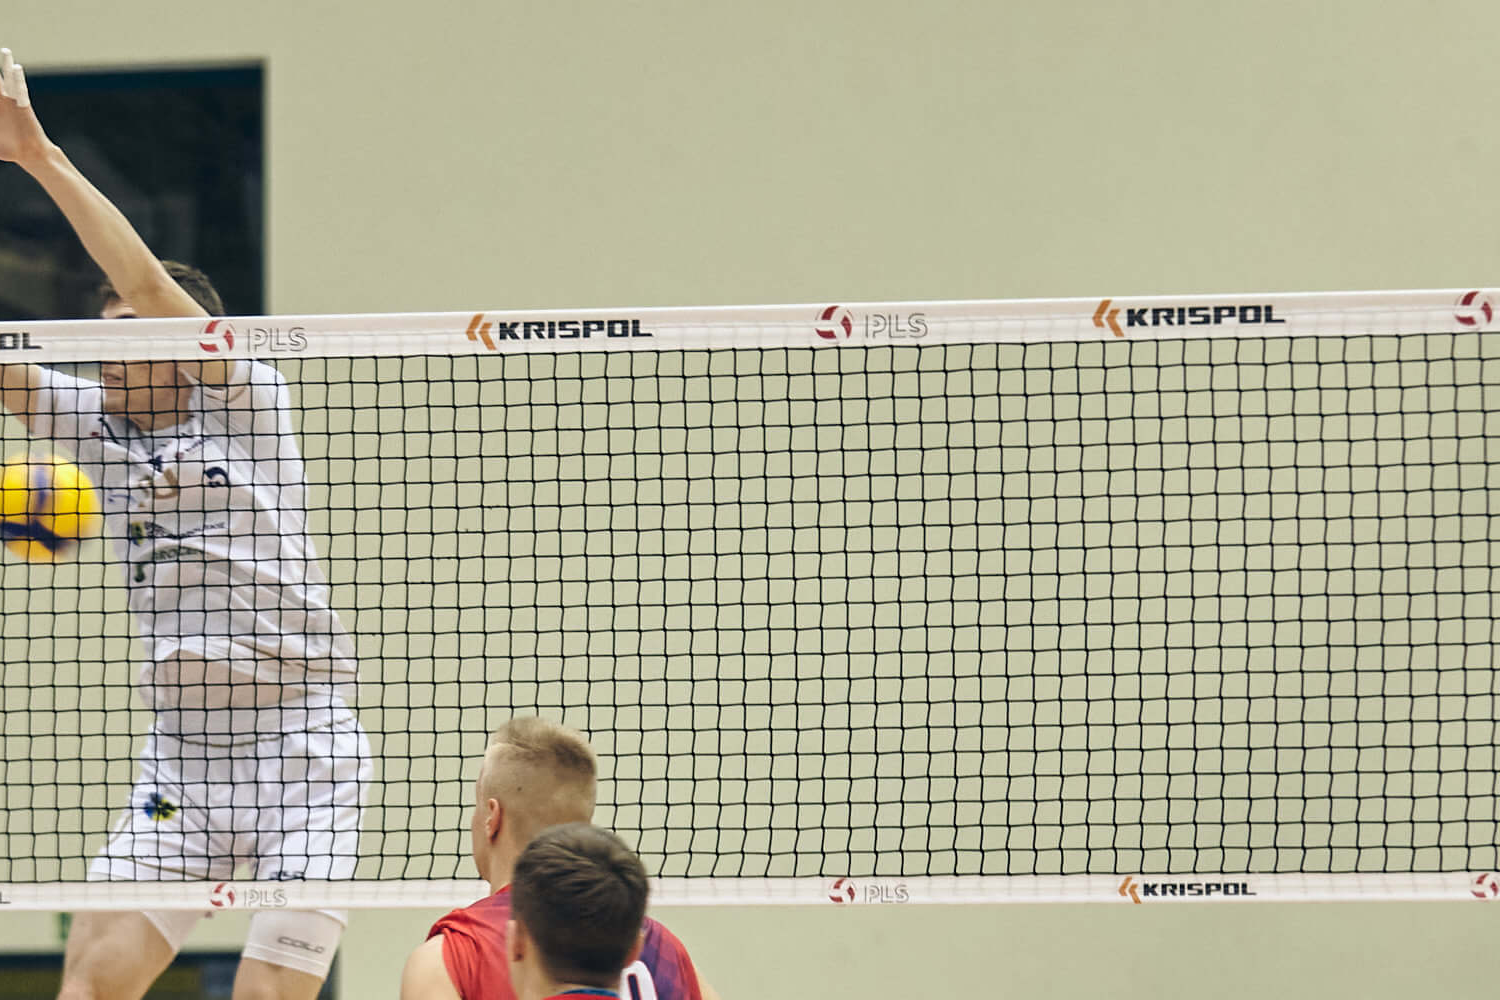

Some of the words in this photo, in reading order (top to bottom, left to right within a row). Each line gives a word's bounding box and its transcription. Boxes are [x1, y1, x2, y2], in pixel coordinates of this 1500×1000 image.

[863, 312, 929, 340] PLS
[1127, 304, 1286, 328] KRISPOL
[246, 326, 309, 353] PLS
[498, 319, 653, 340] KRISPOL
[243, 888, 288, 908] PLS
[862, 883, 910, 905] PLS
[1142, 881, 1257, 899] KRISPOL
